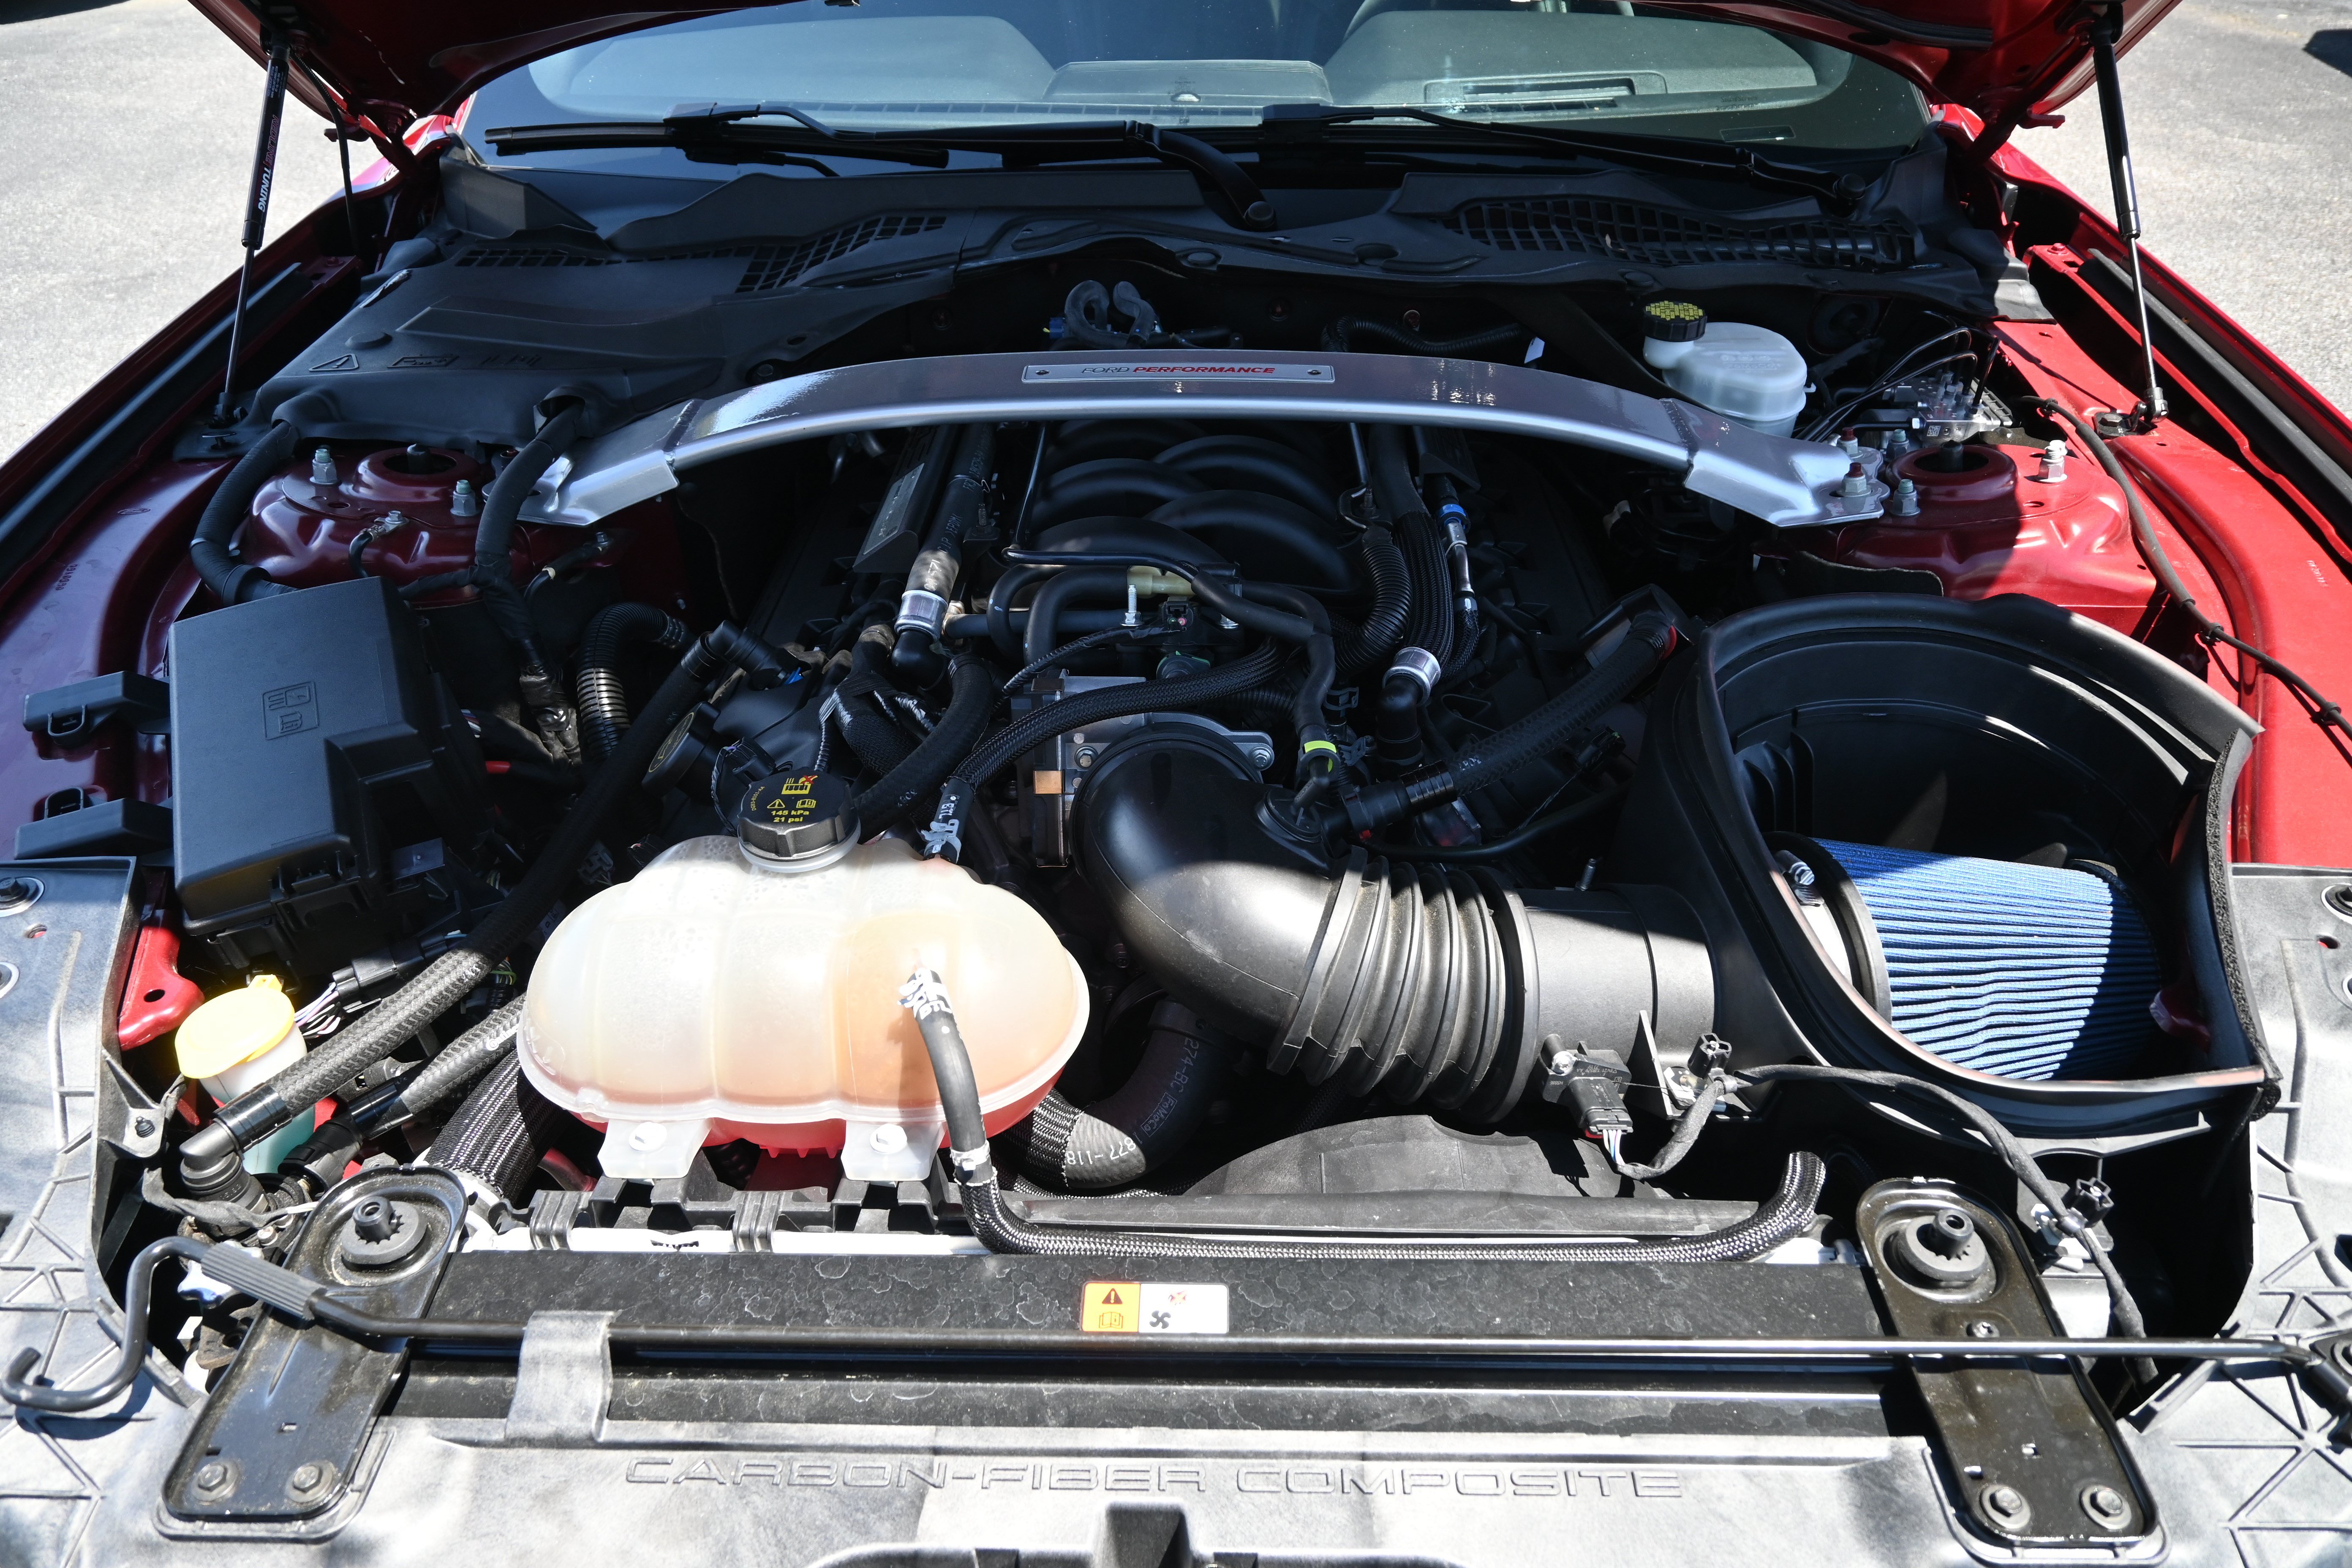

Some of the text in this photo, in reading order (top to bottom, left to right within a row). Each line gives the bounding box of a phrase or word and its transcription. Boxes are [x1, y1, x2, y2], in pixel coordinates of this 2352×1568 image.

[258, 114, 279, 212] REDLINE TUNING
[626, 1457, 1683, 1498] CARBON-FIBER COMPOSITE
